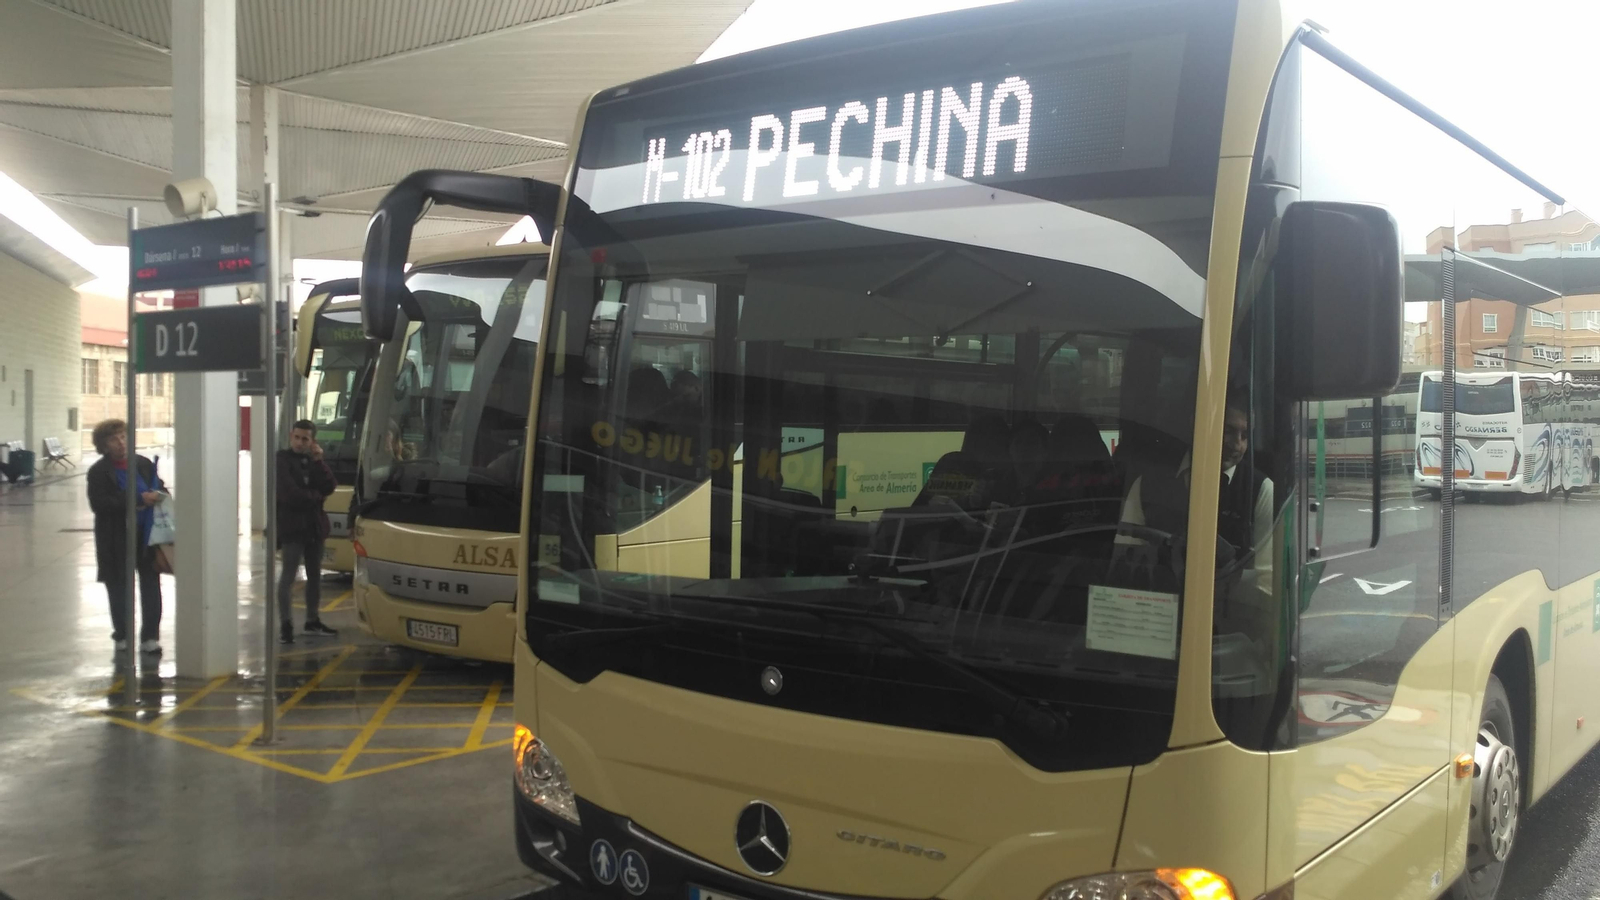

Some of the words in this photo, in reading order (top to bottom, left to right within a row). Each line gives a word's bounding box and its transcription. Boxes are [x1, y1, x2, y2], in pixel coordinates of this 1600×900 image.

[742, 76, 1033, 202] PECHINA
[155, 324, 169, 357] D
[175, 321, 199, 357] 12
[885, 481, 917, 494] Almería
[453, 544, 518, 569] ALSA
[392, 574, 469, 595] SETRA
[836, 829, 946, 861] CITARO
